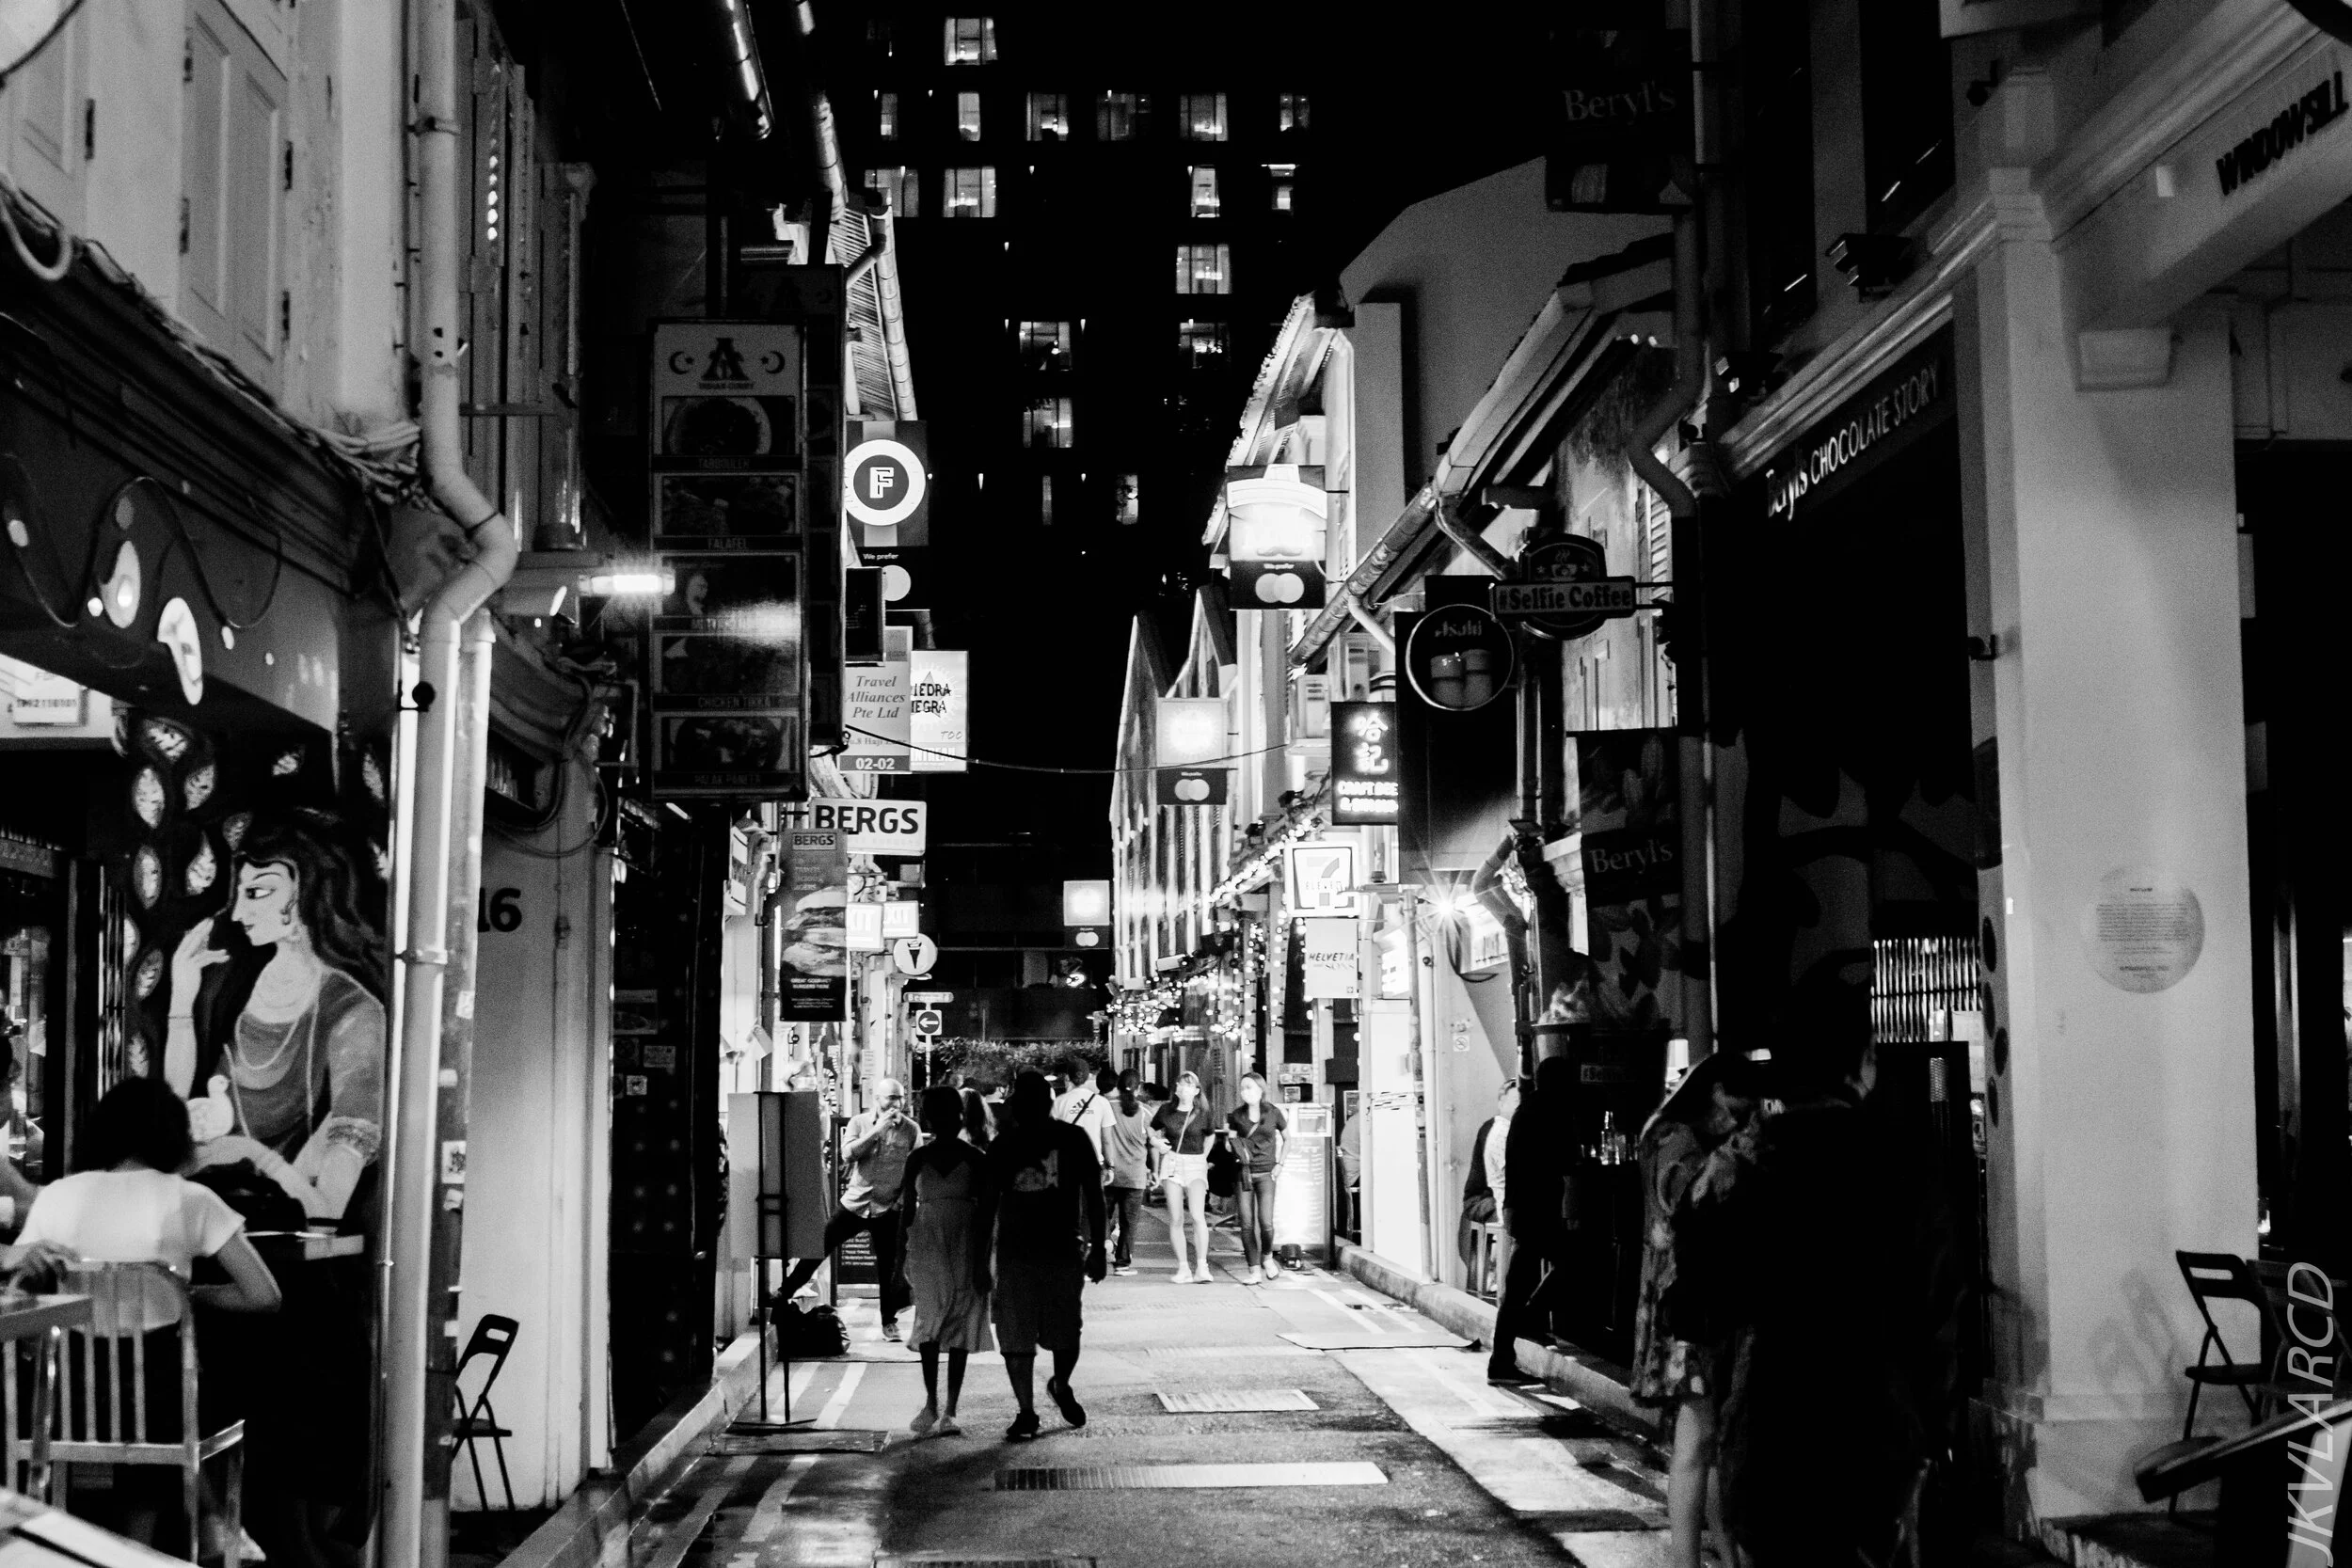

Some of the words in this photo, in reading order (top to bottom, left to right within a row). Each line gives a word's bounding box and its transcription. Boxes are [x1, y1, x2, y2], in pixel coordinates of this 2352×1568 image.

[1561, 79, 1677, 127] Beryl's
[2217, 71, 2350, 196] WINDOWSILL
[1810, 396, 1891, 485] CHOCOLATE
[1893, 357, 1939, 427] STORY
[1499, 586, 1565, 610] #Selfie
[1568, 585, 1630, 608] Coffee
[856, 675, 897, 688] Travel
[911, 683, 951, 697] IEDRA
[846, 691, 906, 704] Alliances
[852, 706, 874, 718] Pte
[877, 706, 900, 718] Ltd
[941, 730, 963, 740] TOO
[855, 758, 896, 770] 02-02
[815, 804, 919, 835] BERGS
[794, 835, 834, 846] BERGS
[1588, 839, 1675, 876] Beryl's
[477, 887, 523, 933] 16
[1309, 952, 1355, 962] HELVETIA
